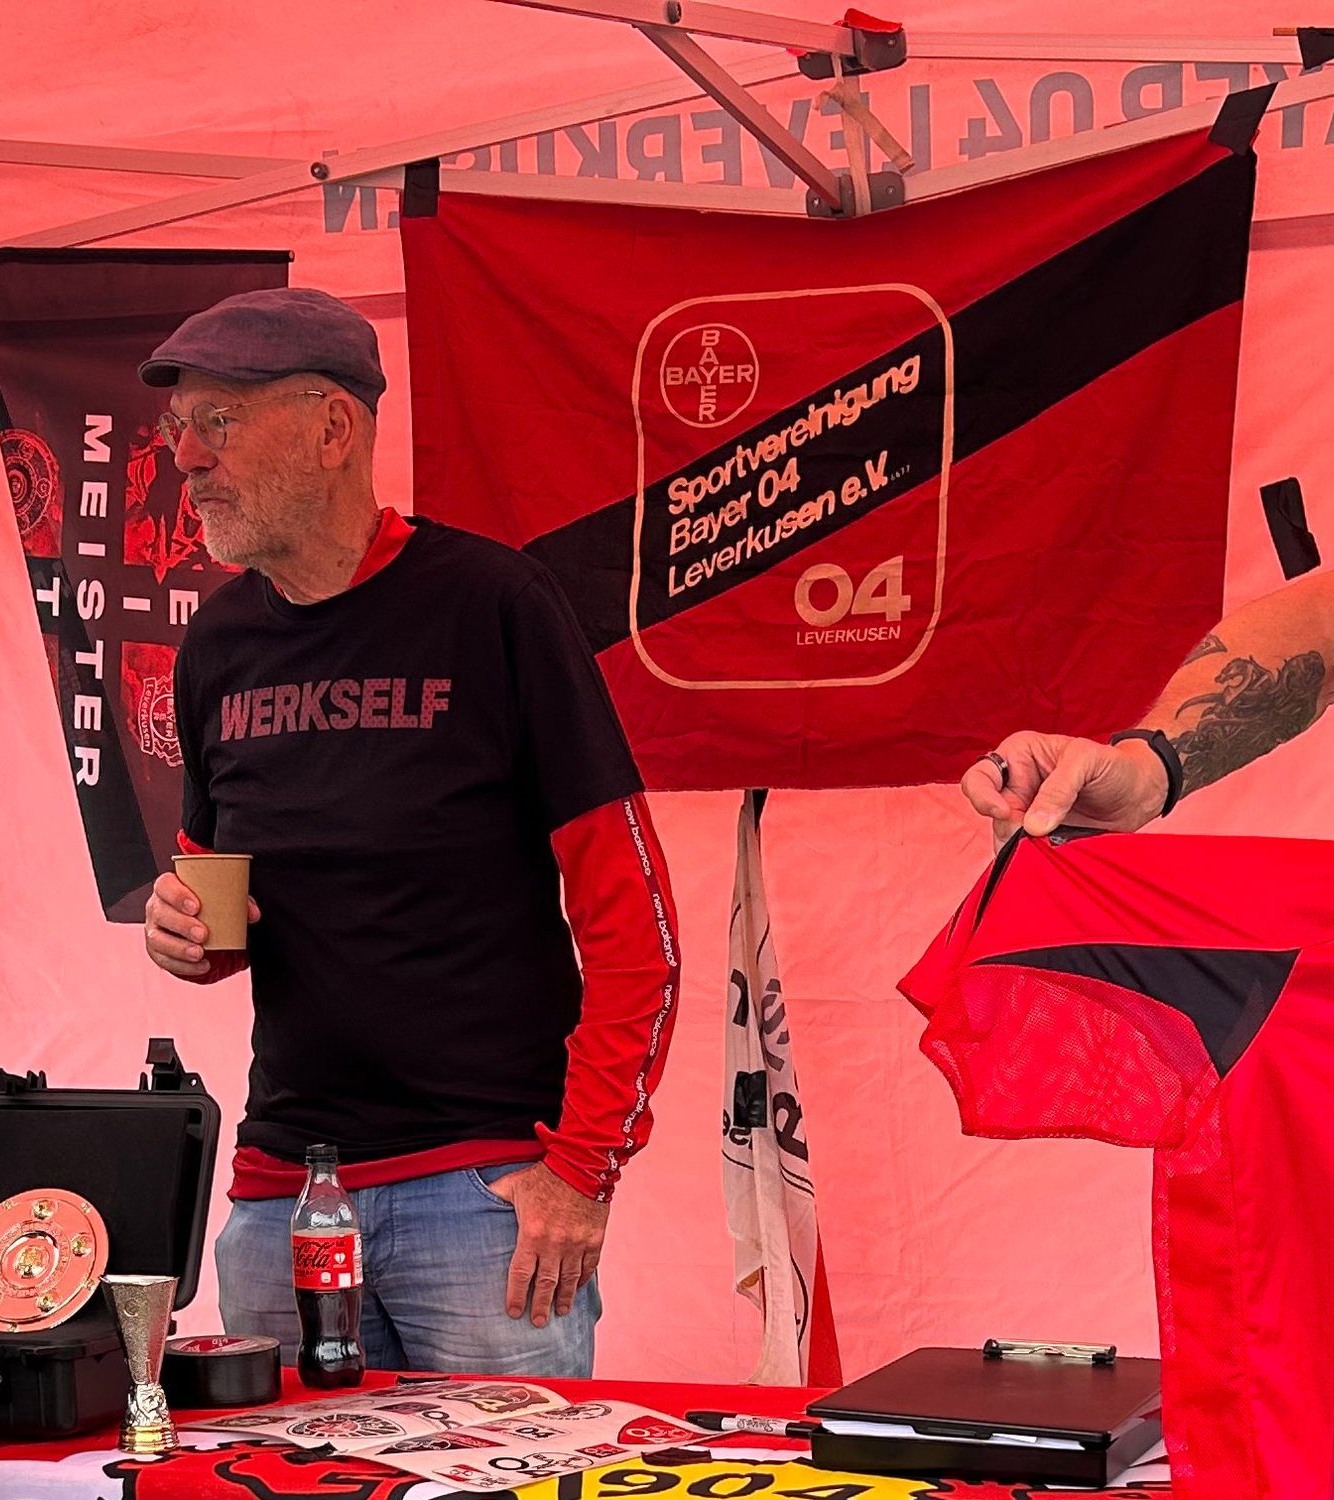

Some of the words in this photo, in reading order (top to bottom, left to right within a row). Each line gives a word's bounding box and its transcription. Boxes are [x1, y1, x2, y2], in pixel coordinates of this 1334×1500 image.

[666, 364, 755, 387] BAYER
[668, 354, 921, 516] Sportvereinigung
[669, 491, 752, 556] Bayer
[757, 457, 801, 508] 04
[669, 490, 836, 598] Leverkusen
[73, 414, 114, 787] MEISTER
[794, 555, 912, 628] 04
[796, 626, 902, 647] LEVERKUSEN
[218, 676, 453, 742] WERKSELF
[623, 801, 637, 825] new
[629, 825, 654, 877] balance
[651, 892, 665, 919] new
[661, 983, 675, 1009] new
